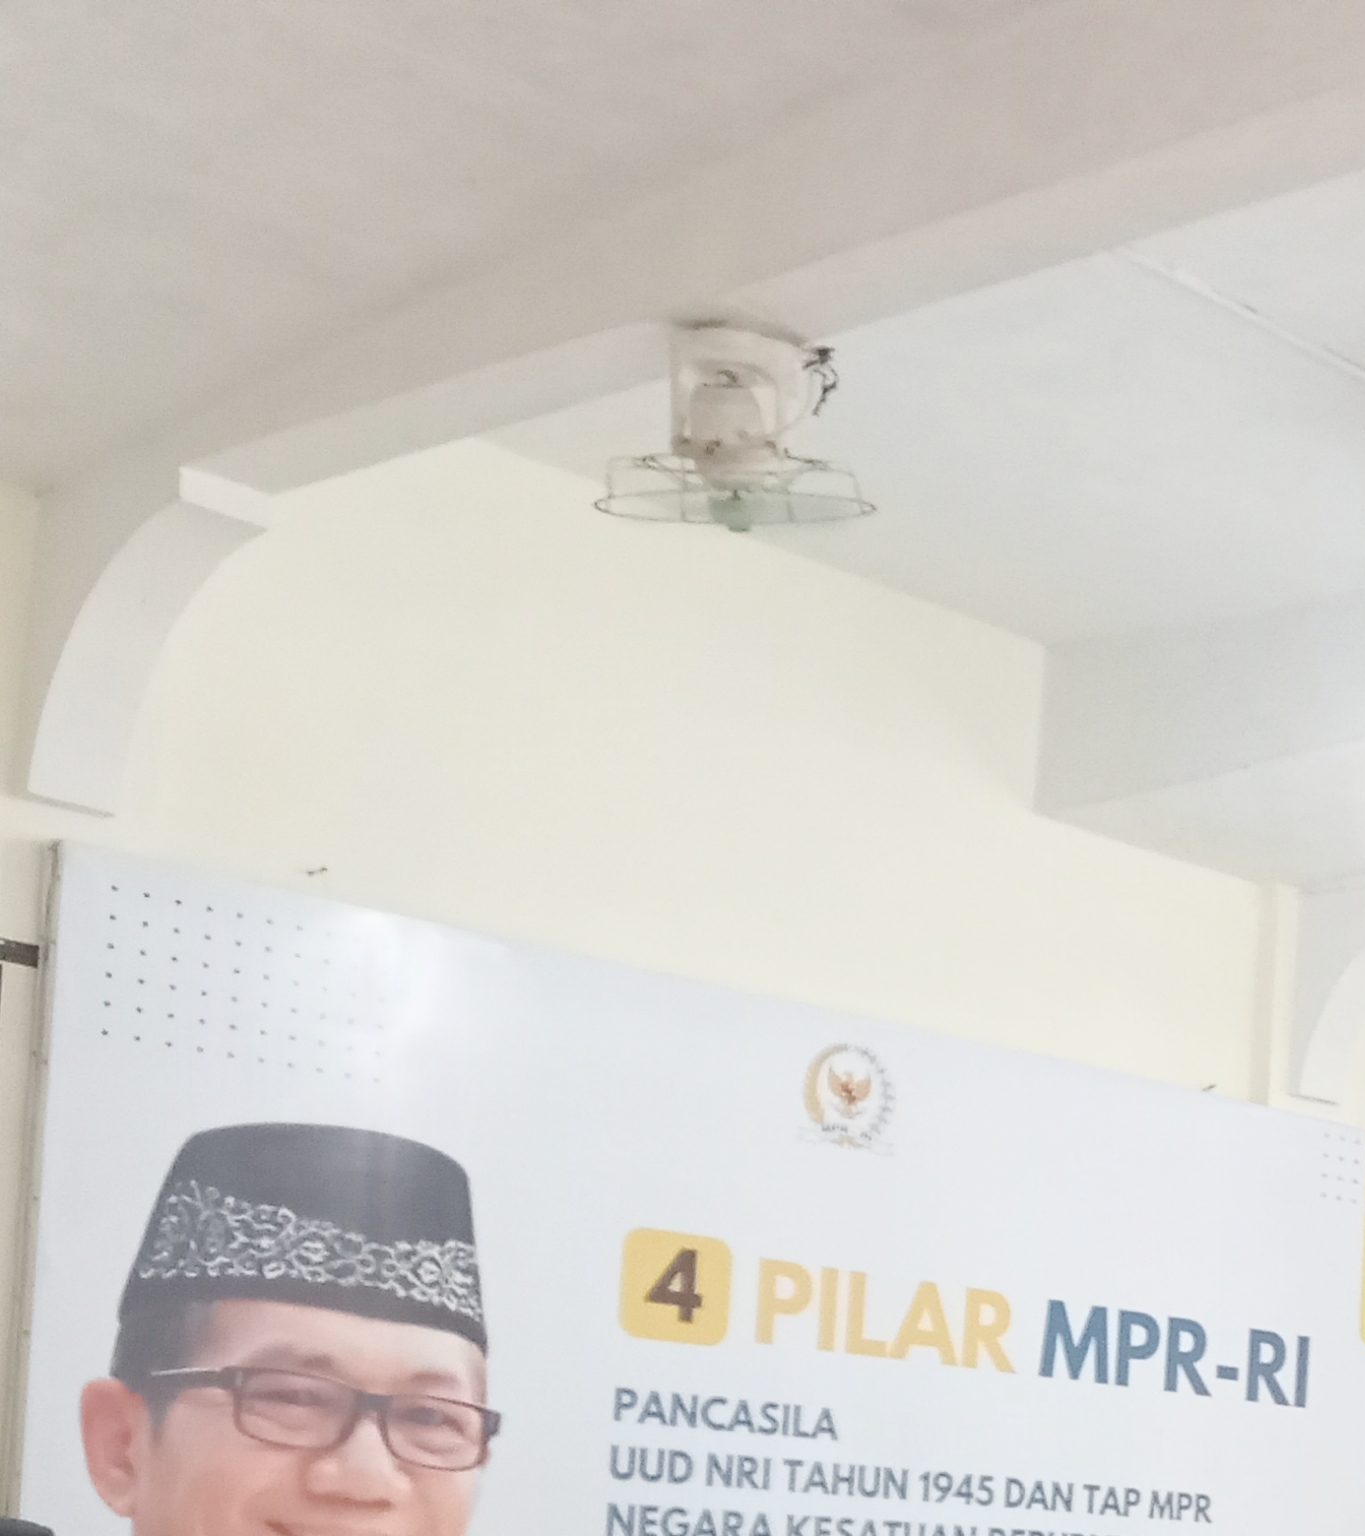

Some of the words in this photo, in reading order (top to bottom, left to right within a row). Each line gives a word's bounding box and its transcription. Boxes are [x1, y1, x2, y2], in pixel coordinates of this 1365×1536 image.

[644, 1246, 703, 1325] 4
[754, 1256, 1017, 1375] PILAR
[1038, 1298, 1311, 1409] MPR-RI
[612, 1386, 839, 1442] PANCASILA
[608, 1444, 694, 1485] UUD
[704, 1451, 773, 1491] NRI
[783, 1457, 910, 1501] TAHUN
[917, 1469, 995, 1507] 1945
[1003, 1476, 1074, 1513] DAN
[1082, 1483, 1141, 1518] TAP
[1147, 1489, 1213, 1524] MPR
